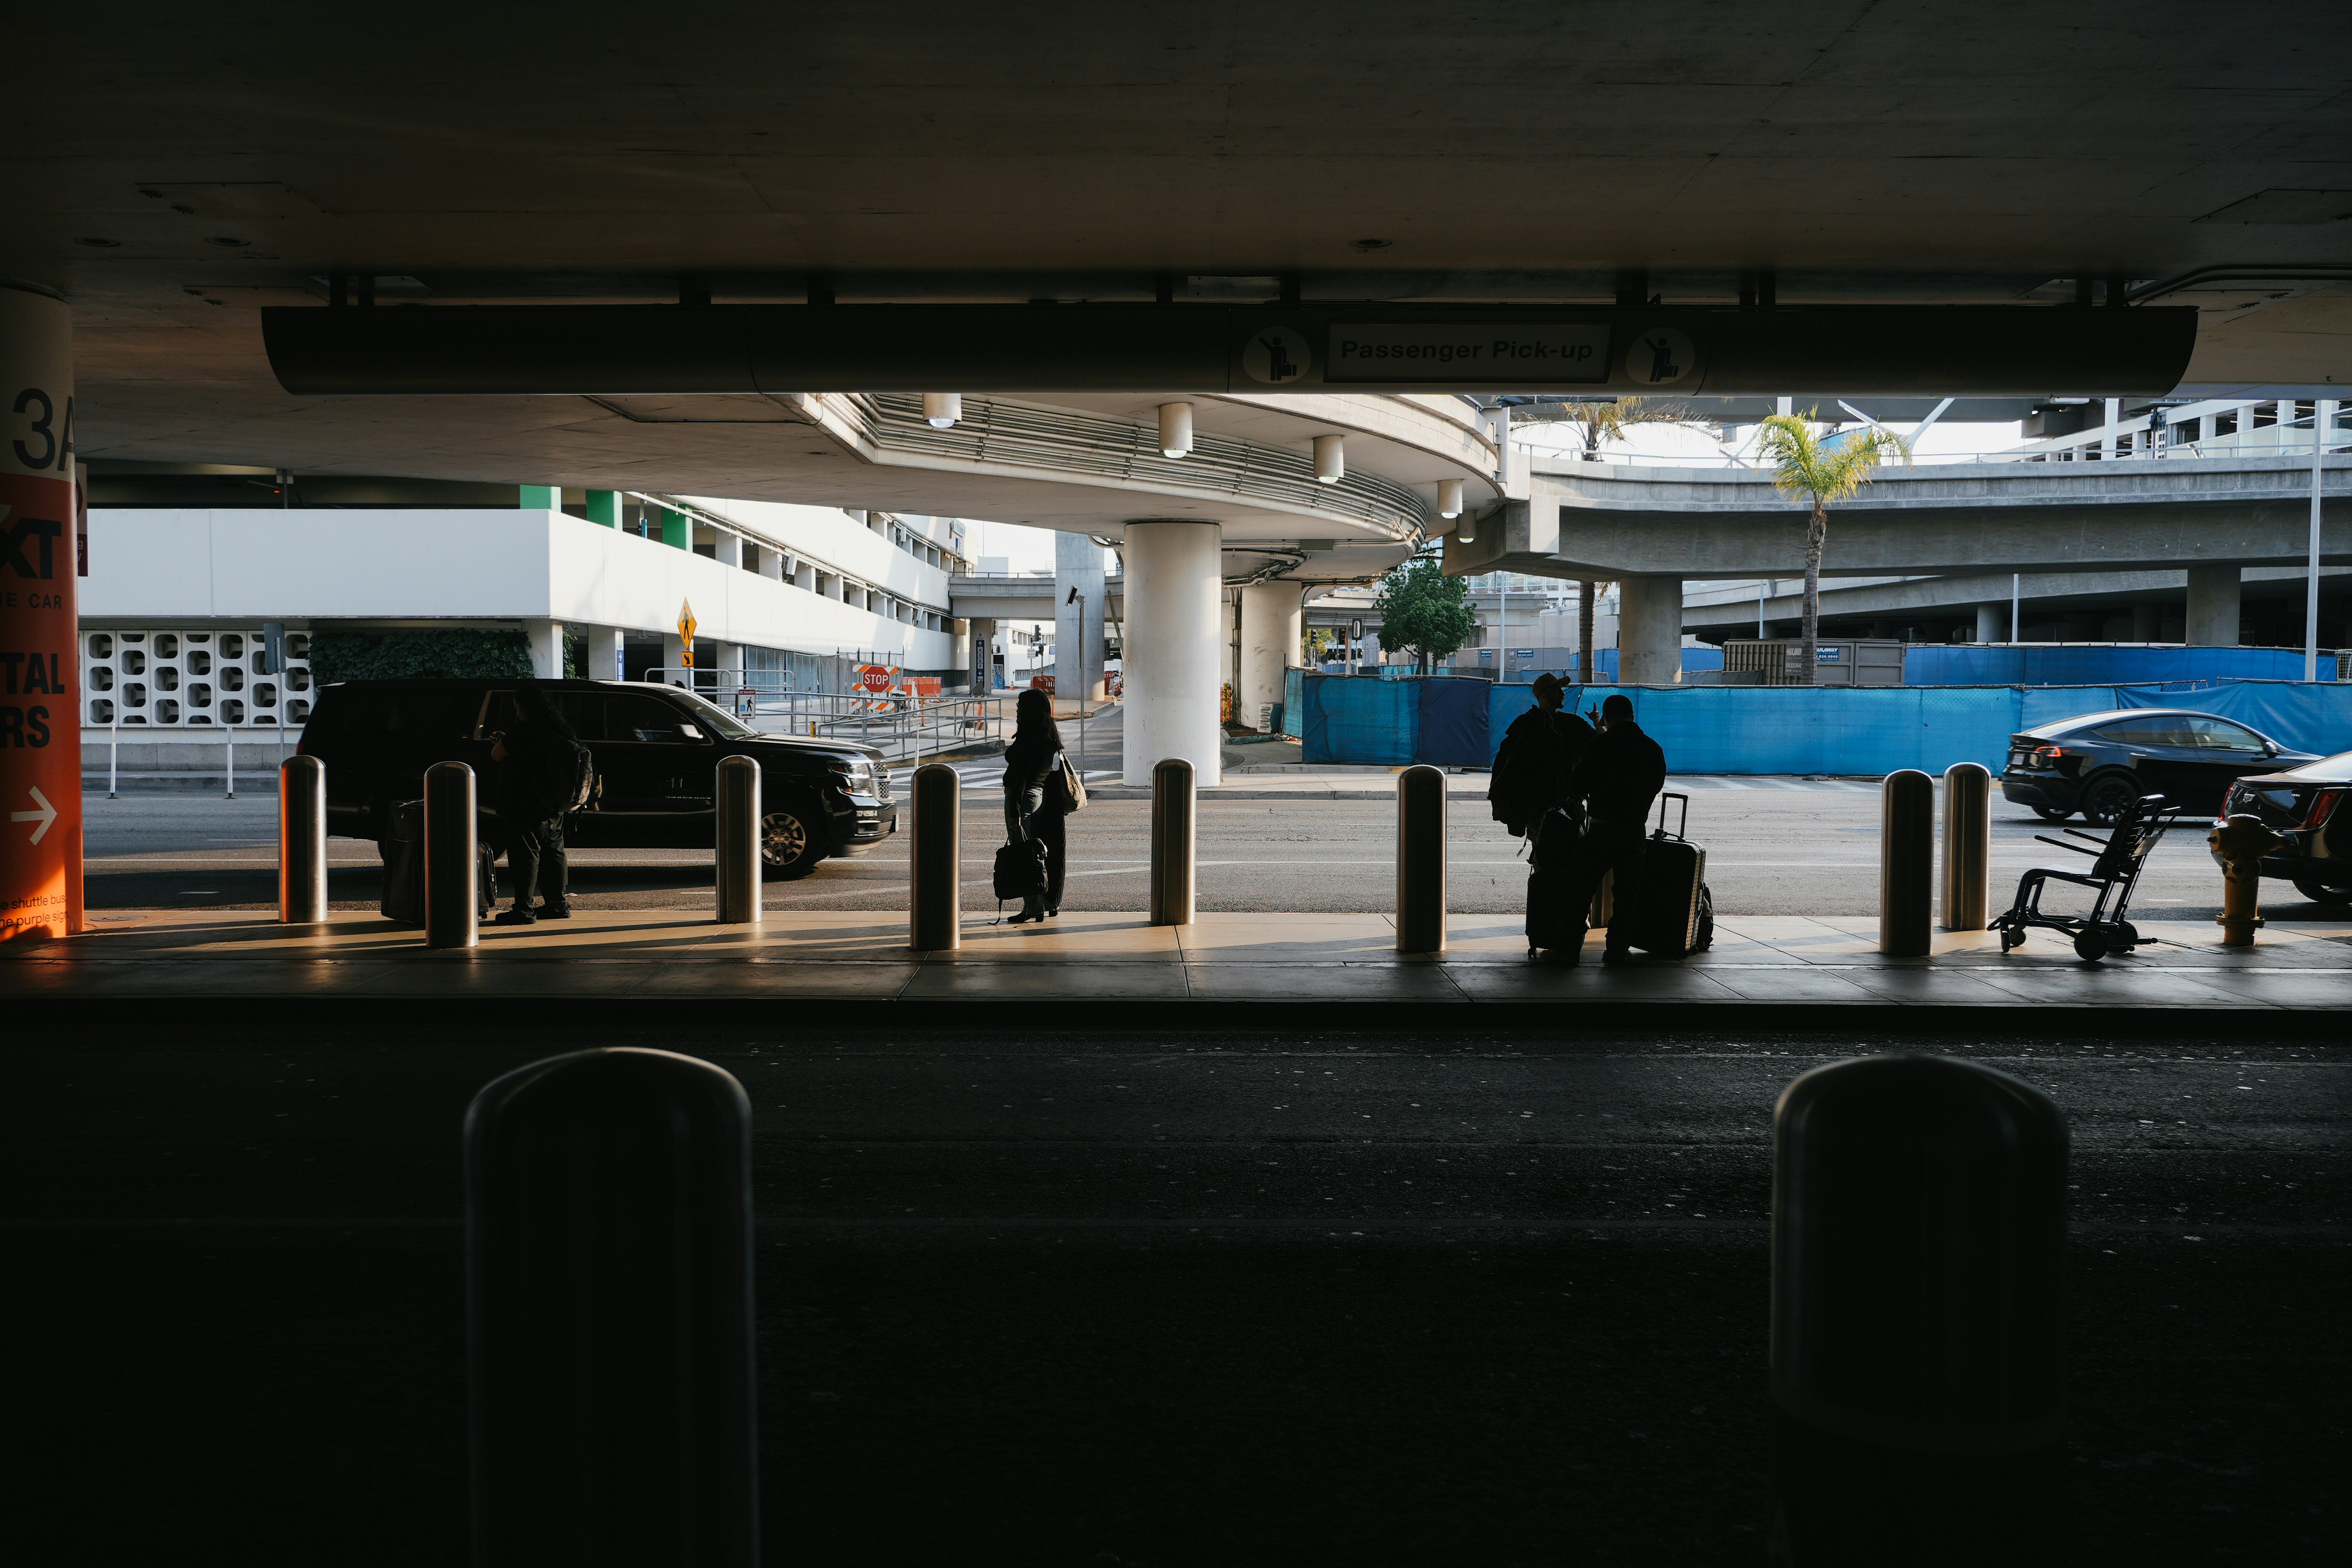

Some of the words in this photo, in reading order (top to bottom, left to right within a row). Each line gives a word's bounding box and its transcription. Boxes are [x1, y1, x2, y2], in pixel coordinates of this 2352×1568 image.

[1341, 341, 1482, 362] Passenger
[1494, 341, 1593, 362] Pick-up
[29, 593, 61, 609] CAR
[0, 652, 65, 694] TAL
[864, 674, 888, 685] STOP
[0, 706, 50, 748] RS
[11, 895, 48, 909] shuttle
[16, 913, 50, 929] purple
